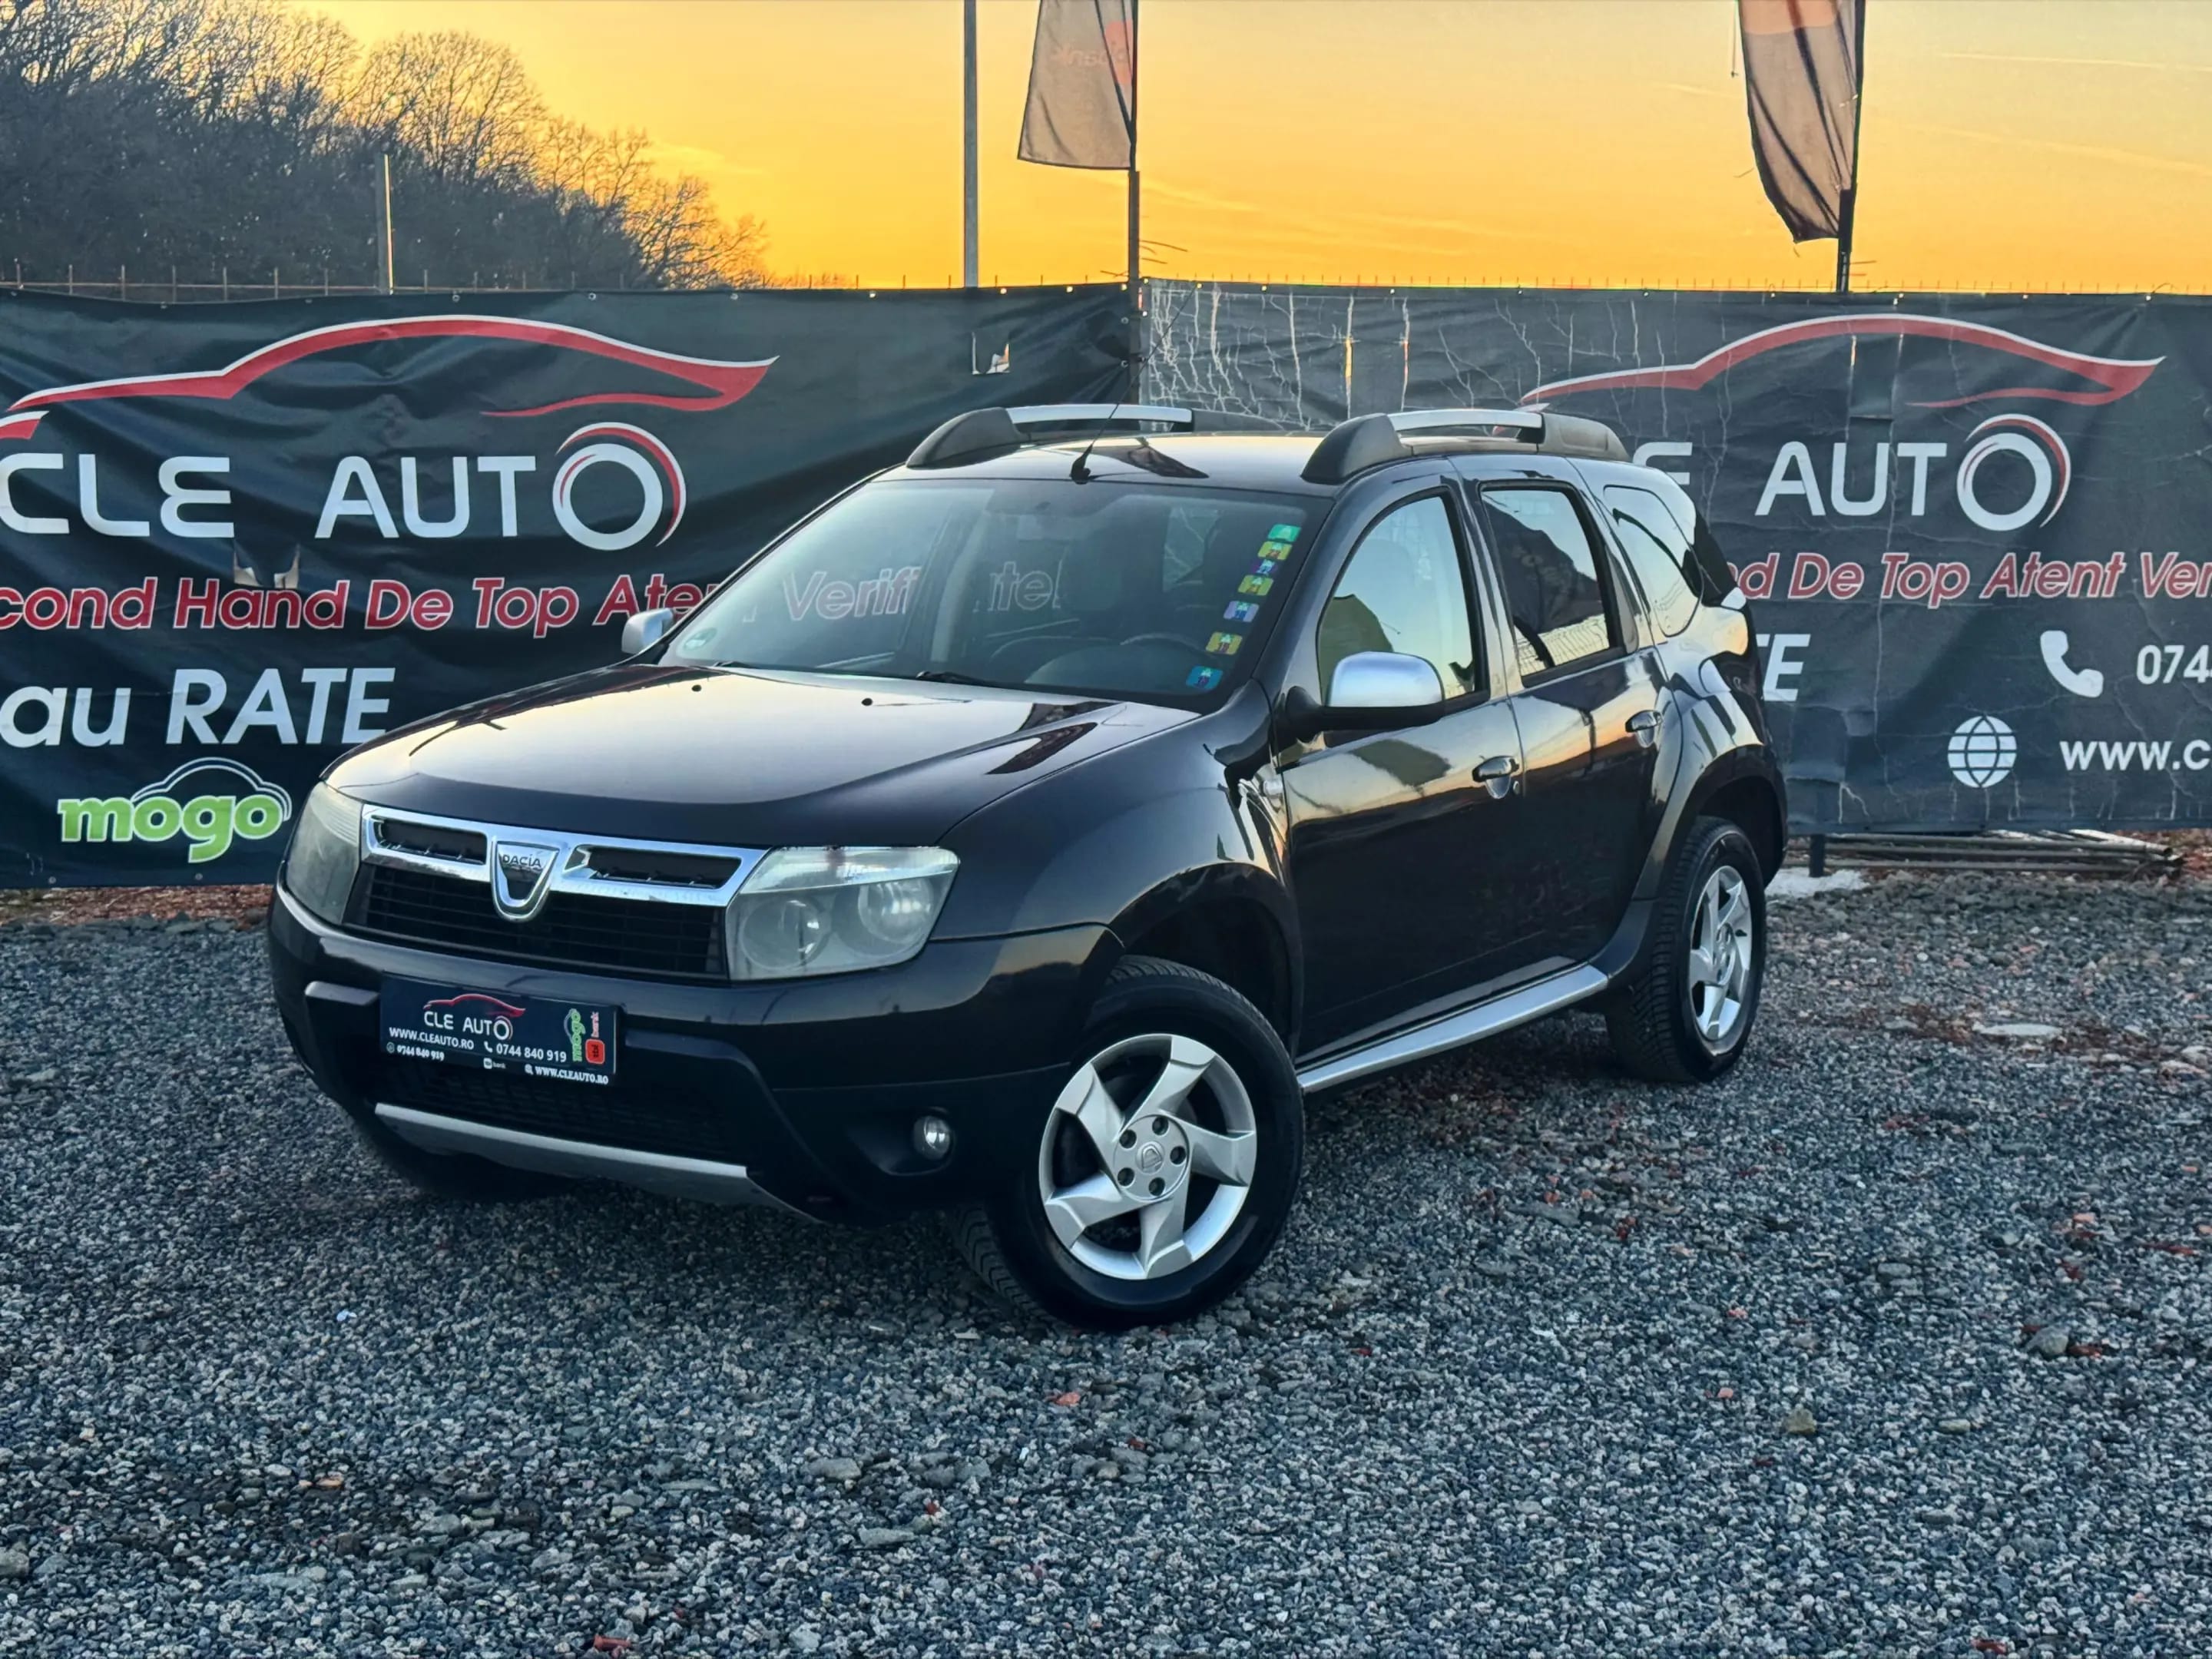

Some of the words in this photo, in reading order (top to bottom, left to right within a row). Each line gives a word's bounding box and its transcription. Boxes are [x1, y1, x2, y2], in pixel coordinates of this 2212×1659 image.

[0, 453, 234, 538] CLE
[315, 443, 663, 551] AUTO
[1755, 432, 2052, 531] AUTO
[1787, 552, 1864, 599] De
[1880, 552, 1970, 608] Top
[1979, 551, 2127, 598] Atent
[174, 579, 350, 631] Hand
[365, 579, 453, 631] De
[473, 578, 579, 638] Top
[2136, 644, 2212, 684] 074
[0, 686, 131, 747] au
[166, 667, 396, 744] RATE
[58, 794, 284, 863] mogo
[389, 1027, 474, 1050] WWW.CLEAUTO.RO
[424, 1011, 454, 1030] CLE
[462, 1017, 510, 1040] AUTO
[495, 1042, 522, 1057] 0744
[524, 1047, 544, 1061] 840
[546, 1050, 567, 1063] 919
[571, 1008, 586, 1062] mogo
[535, 1066, 608, 1085] WWW.CLEAUTO.RO
